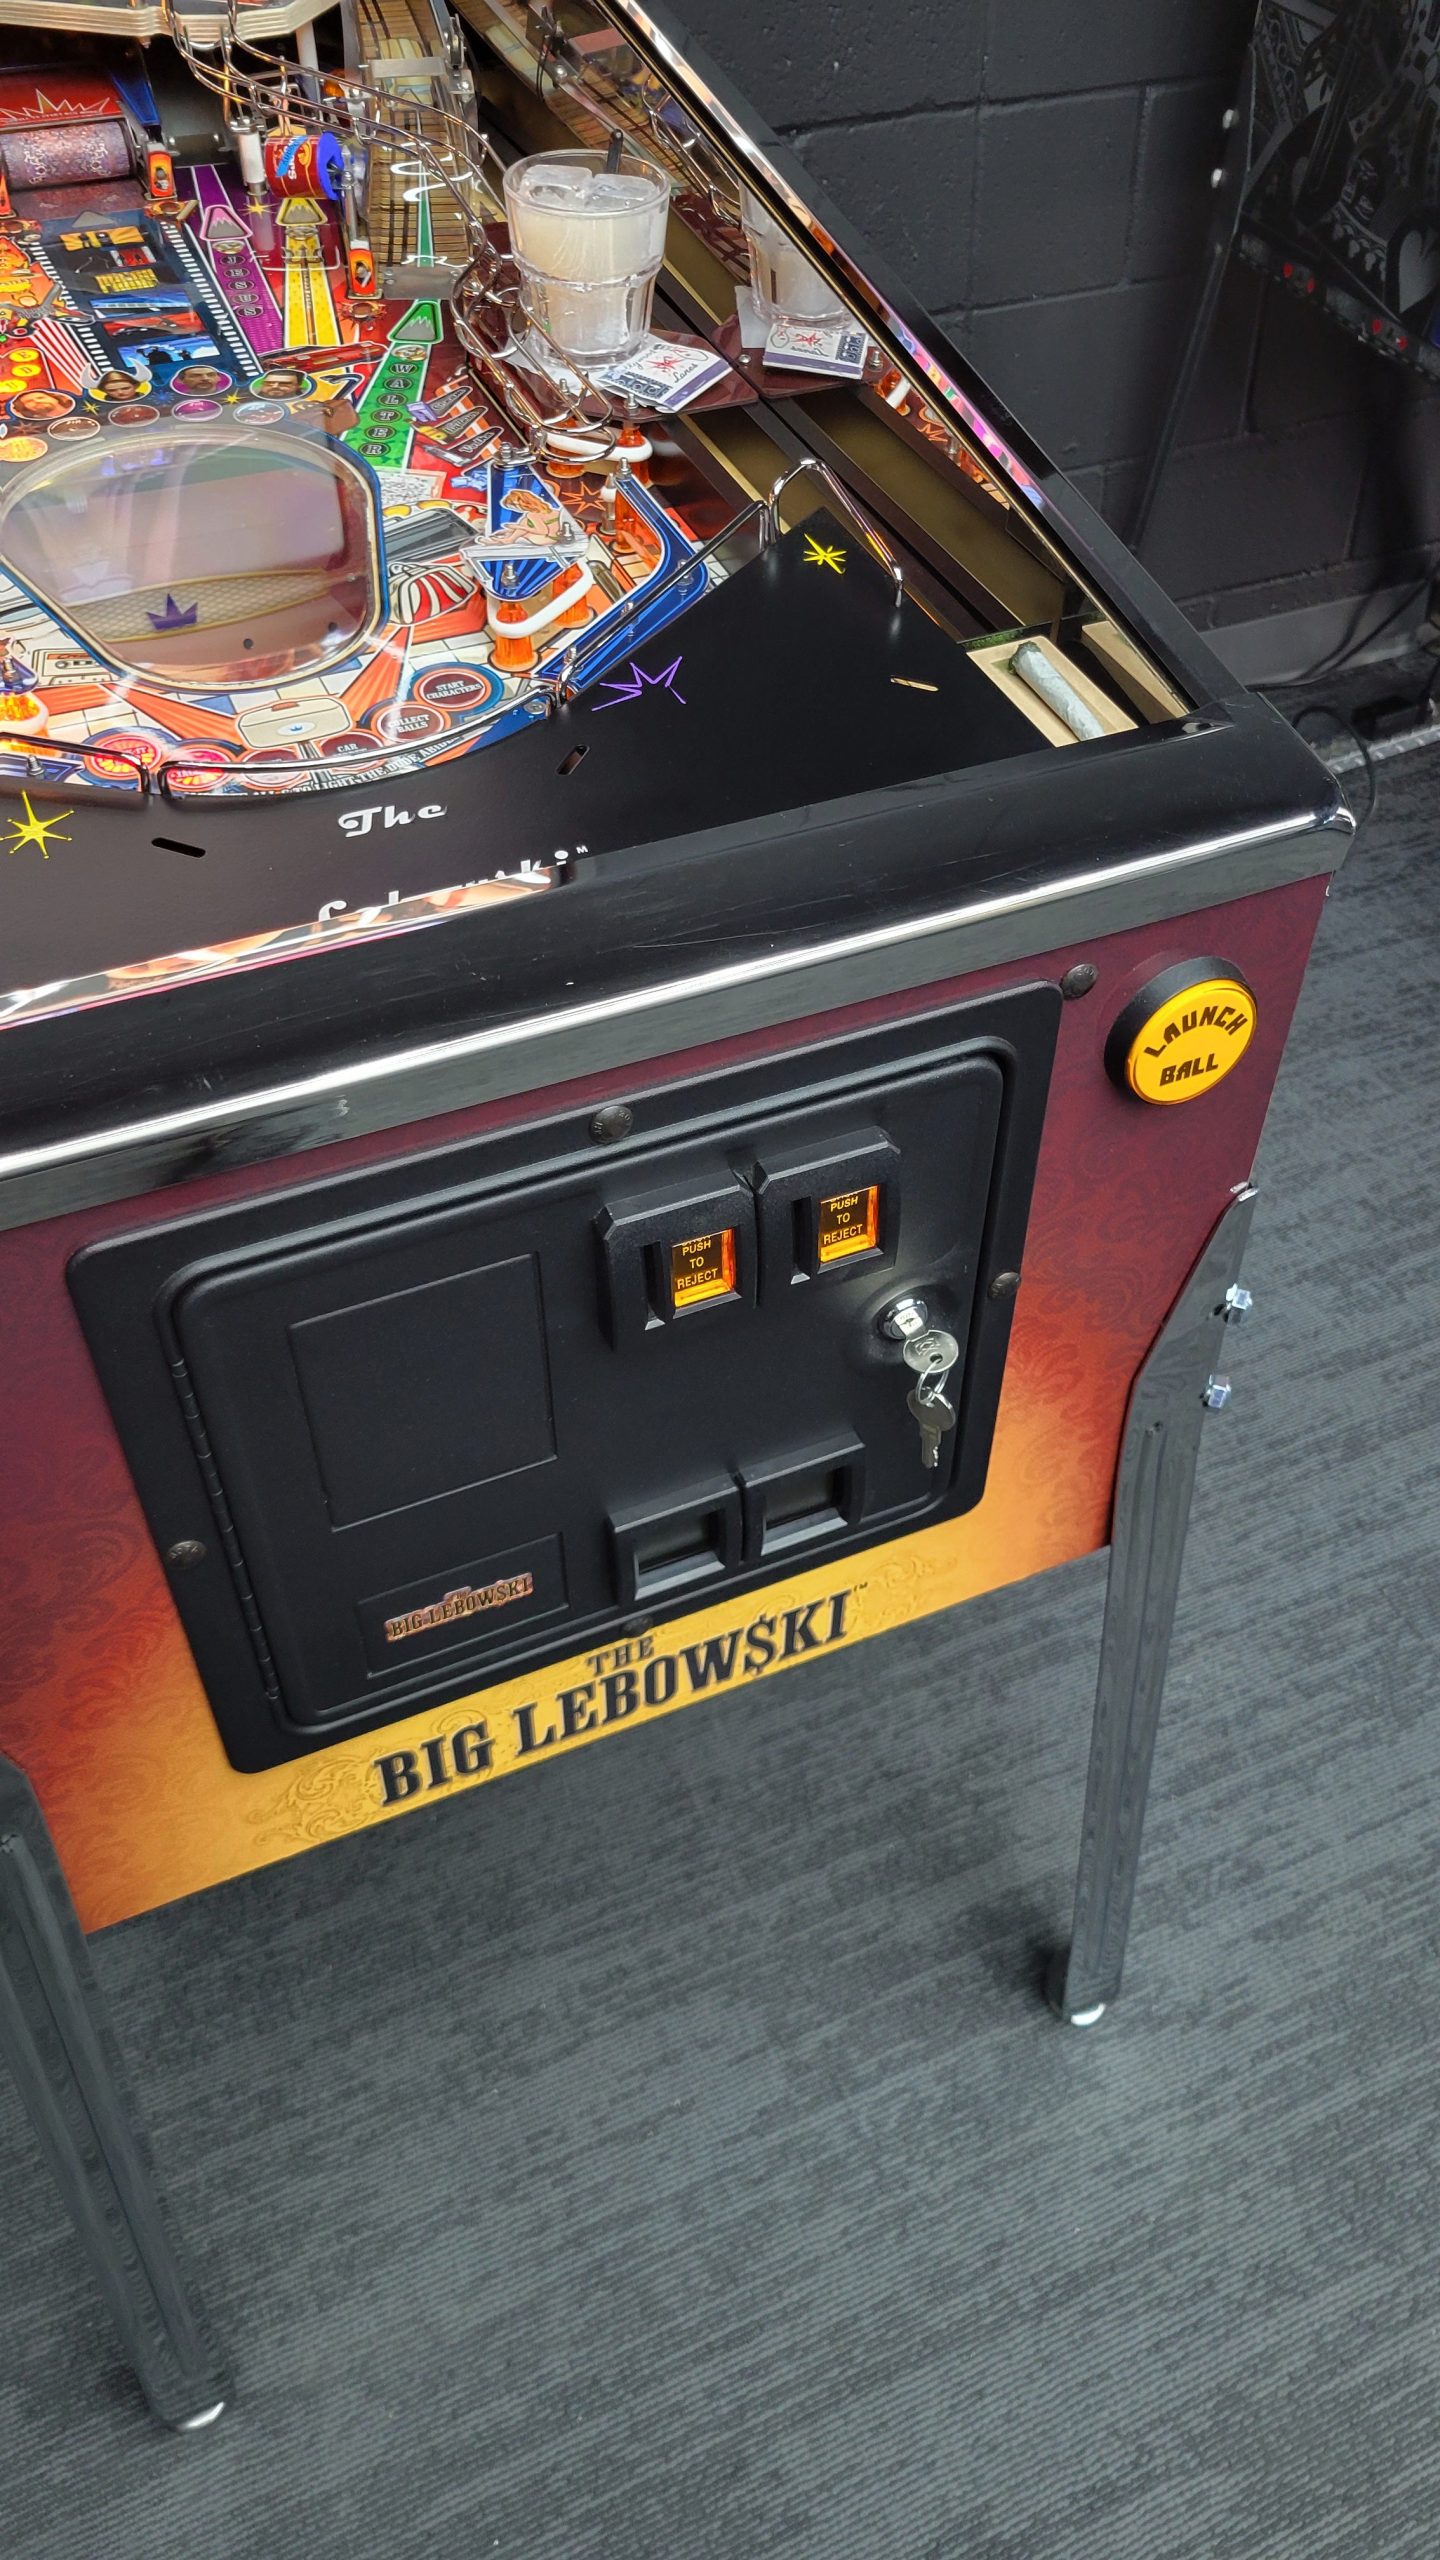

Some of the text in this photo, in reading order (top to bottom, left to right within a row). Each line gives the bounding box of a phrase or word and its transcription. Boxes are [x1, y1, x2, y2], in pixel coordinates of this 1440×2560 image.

[425, 683, 482, 700] CHARACTERS
[435, 680, 465, 692] START
[337, 743, 359, 753] CAR
[356, 762, 387, 780] THE
[385, 753, 421, 772] DUDE
[338, 804, 448, 838] The
[1144, 1005, 1248, 1058] LAUNCH
[1159, 1053, 1219, 1087] BALL
[829, 1195, 859, 1213] PUSH
[836, 1212, 851, 1225] TO
[823, 1223, 863, 1245] REJECT
[682, 1239, 712, 1256] PUSH
[689, 1256, 704, 1269] TO
[677, 1267, 719, 1290] REJECT
[391, 1613, 423, 1638] BIG
[585, 1634, 655, 1677] THE
[374, 1722, 496, 1806] BIG
